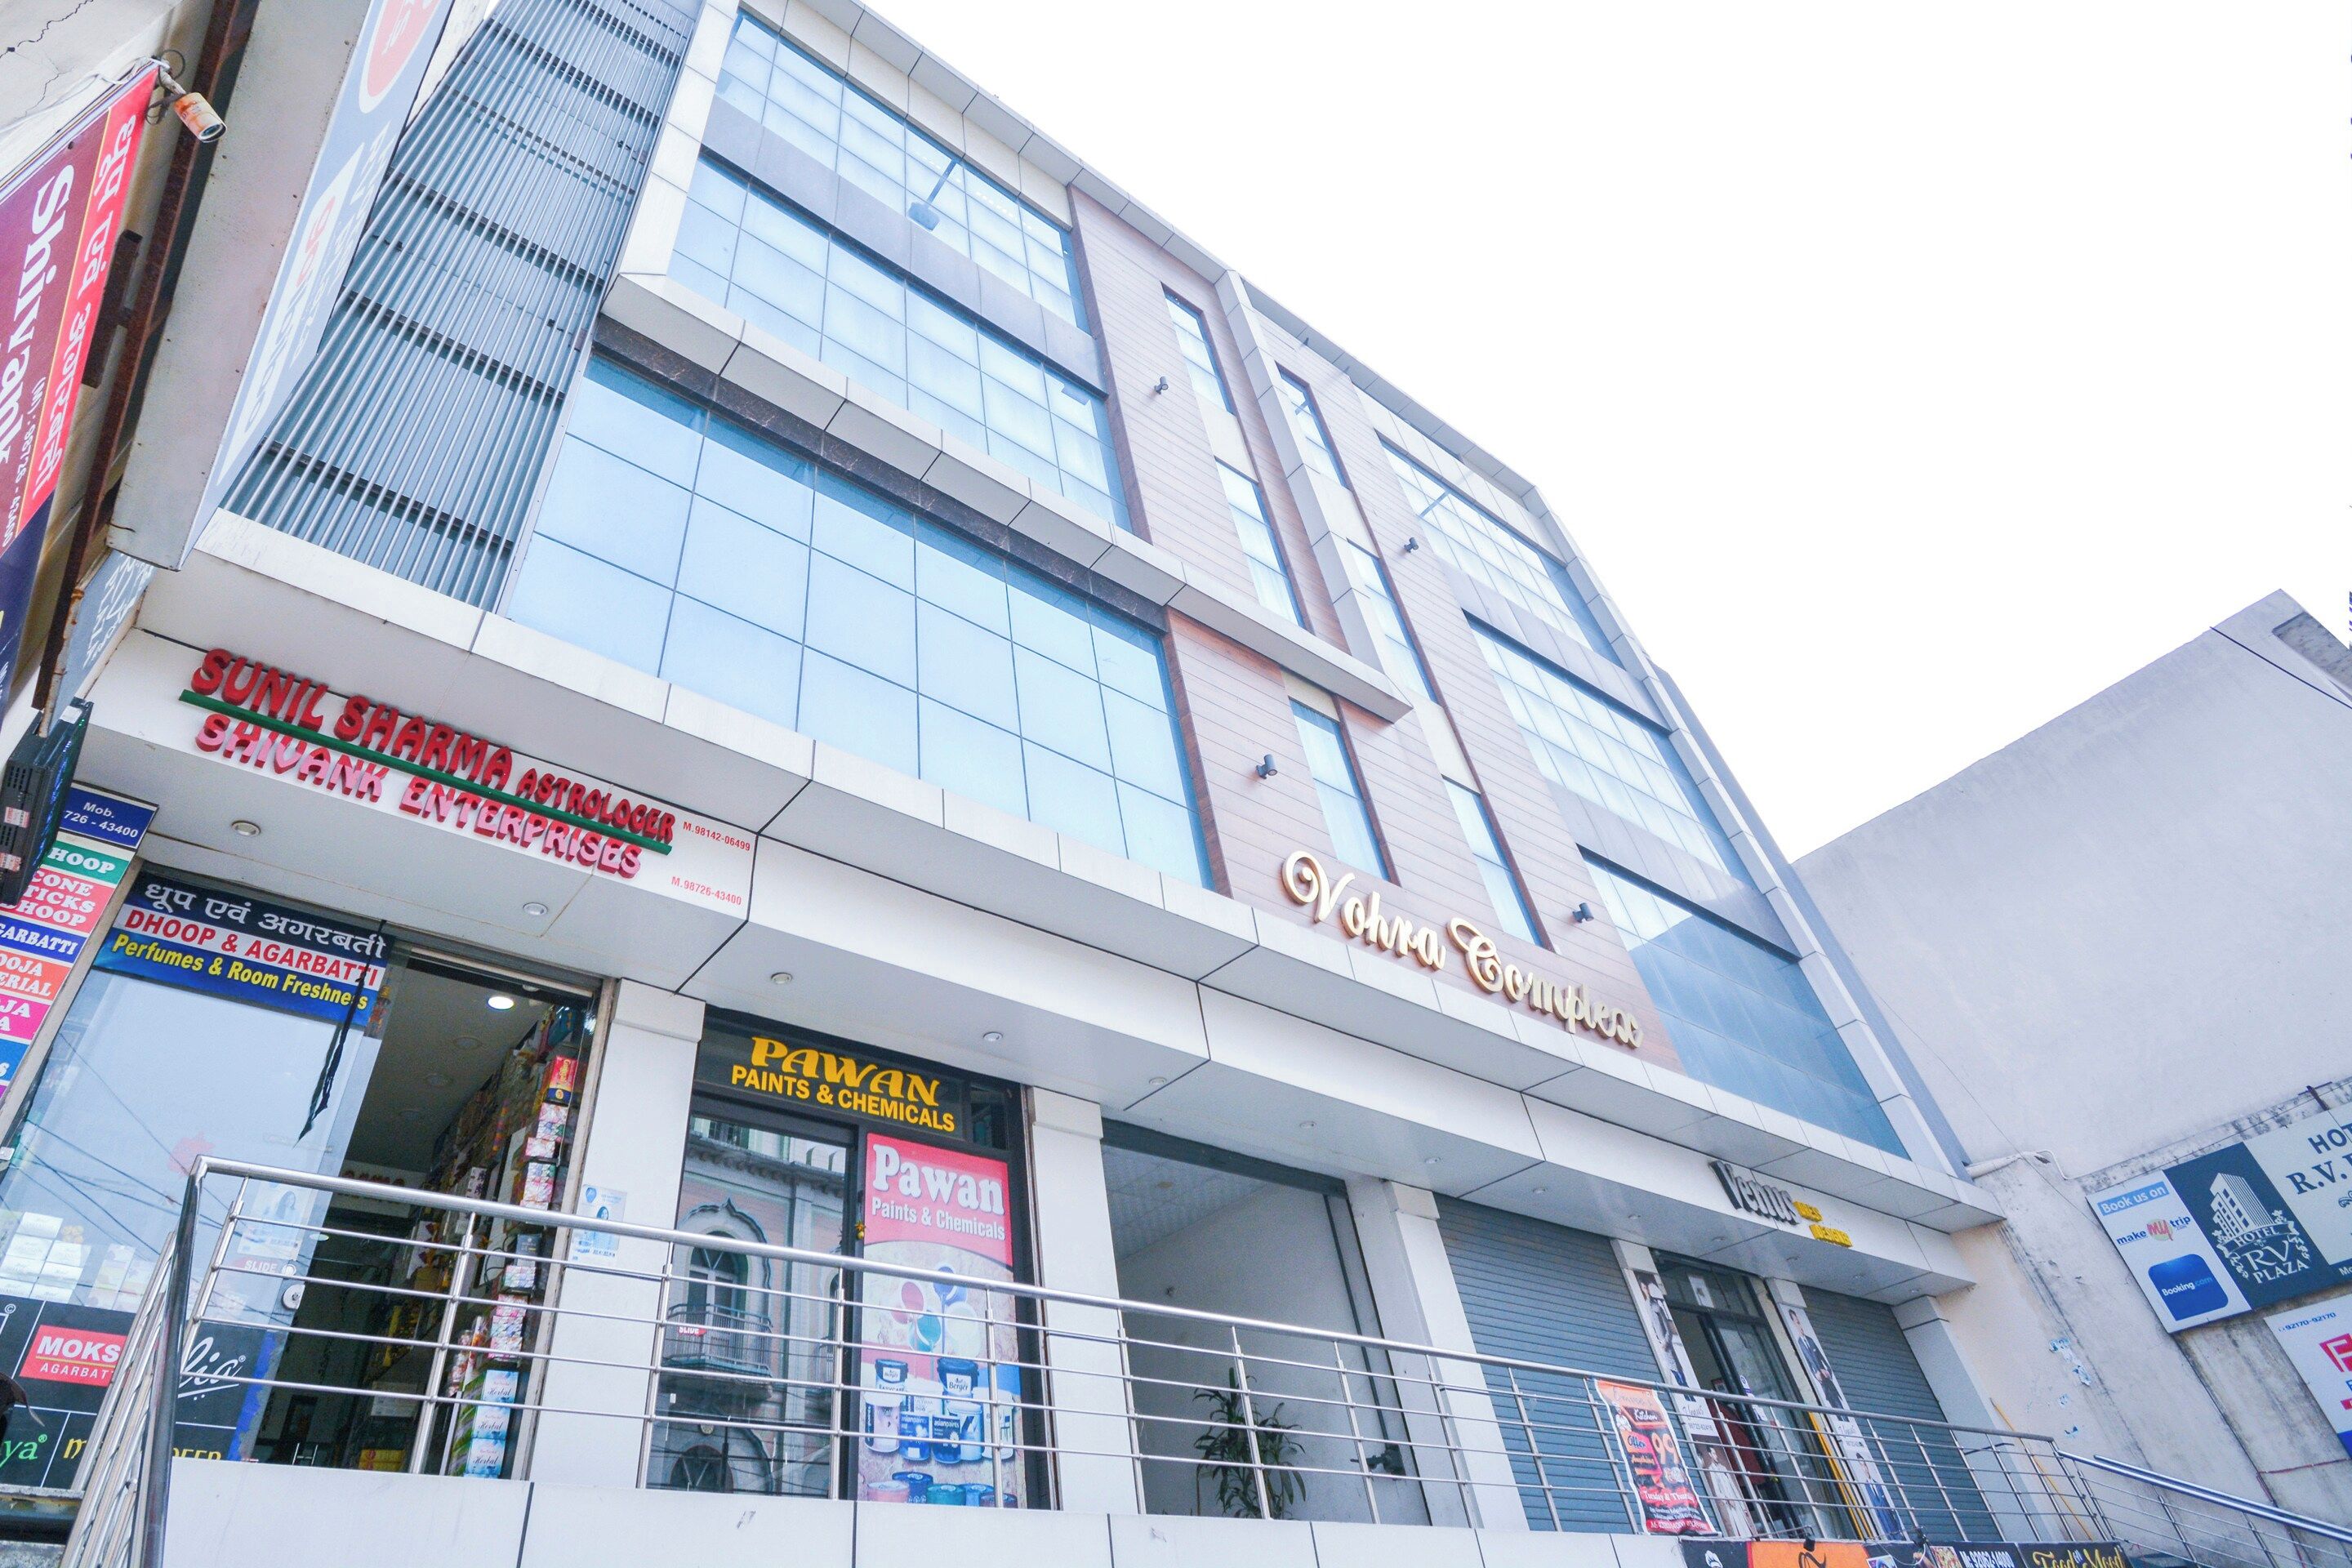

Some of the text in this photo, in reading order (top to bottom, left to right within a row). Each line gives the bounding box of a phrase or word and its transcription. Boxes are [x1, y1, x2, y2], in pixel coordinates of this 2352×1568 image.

[191, 648, 675, 846] SUNIL SHARMA ASTROLOGER
[83, 802, 115, 818] Mob.
[195, 712, 643, 880] SHIVANK ENTERPRISES
[99, 821, 139, 838] 43400
[31, 870, 94, 897] CONE
[145, 883, 196, 914] धूप
[204, 897, 252, 924] एवं
[125, 910, 379, 987] DHOOP & AGARBATTI
[1281, 850, 1645, 1049] Vohra Complex
[111, 934, 368, 1010] Perfumes & Room Freshnes
[751, 1036, 940, 1107] PAWAN
[732, 1065, 956, 1133] PAINTS & CHEMICALS
[872, 1143, 1005, 1216] Pawan
[1708, 1160, 1801, 1226] Venus
[2102, 1185, 2167, 1214] Book us on
[871, 1196, 1006, 1241] Paints & Chemicals
[2234, 1226, 2280, 1249] HOTEL
[243, 1260, 278, 1272] SLIDE
[2240, 1240, 2290, 1272] RV
[2252, 1258, 2310, 1284] PLAZA
[2162, 1276, 2213, 1297] Booking.com
[40, 1362, 114, 1379] AGARBAT
[948, 1381, 969, 1392] Berger
[1651, 1432, 1680, 1465] 99
